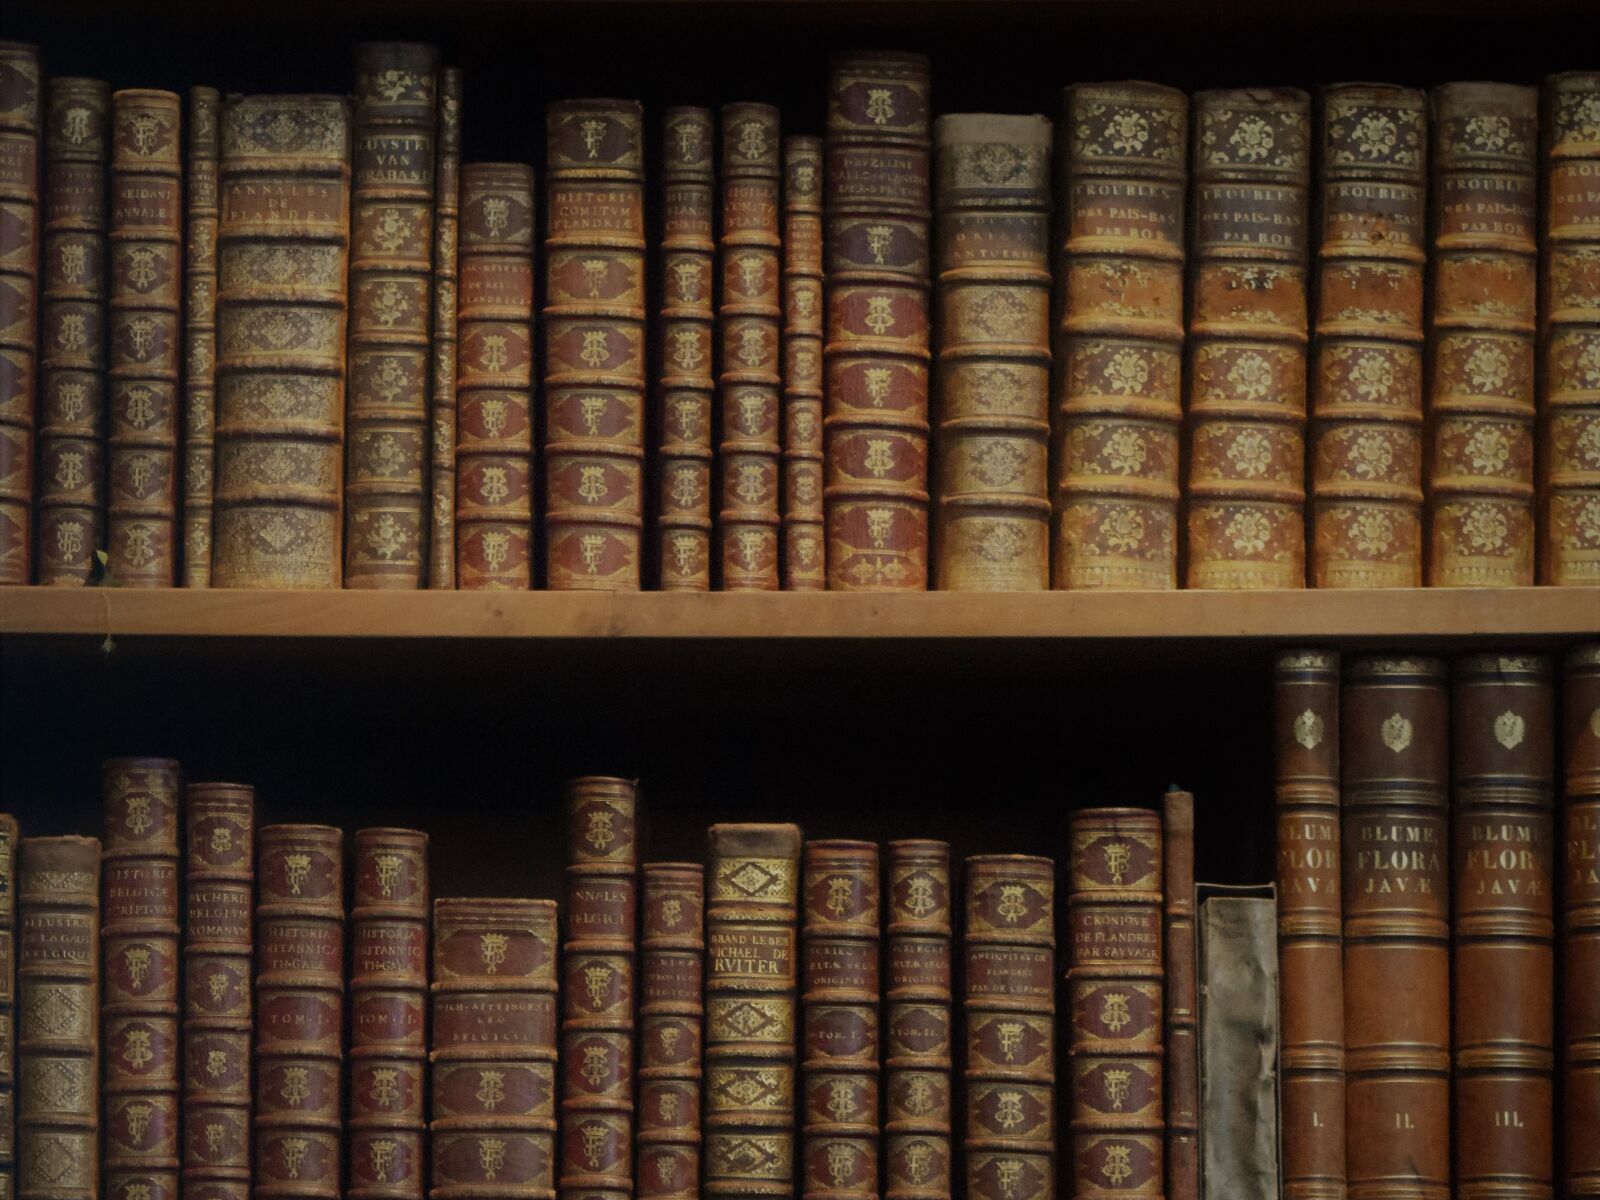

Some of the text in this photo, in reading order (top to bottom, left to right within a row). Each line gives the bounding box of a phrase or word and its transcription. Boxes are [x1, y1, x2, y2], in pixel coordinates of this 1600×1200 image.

[376, 154, 410, 166] VAN
[268, 198, 288, 209] DE
[555, 192, 634, 203] HISTORIA
[1096, 226, 1164, 241] PAR BOR
[1461, 222, 1526, 235] PAR BOR
[1224, 231, 1293, 245] PAR BOR
[1342, 231, 1368, 240] PAR
[1358, 850, 1441, 871] FLORA
[1364, 878, 1432, 894] JAVÆ
[1076, 932, 1092, 943] DE
[773, 949, 789, 960] DE
[714, 959, 780, 974] RVITER
[1395, 1113, 1415, 1129] II.
[1495, 1111, 1524, 1127] III.
